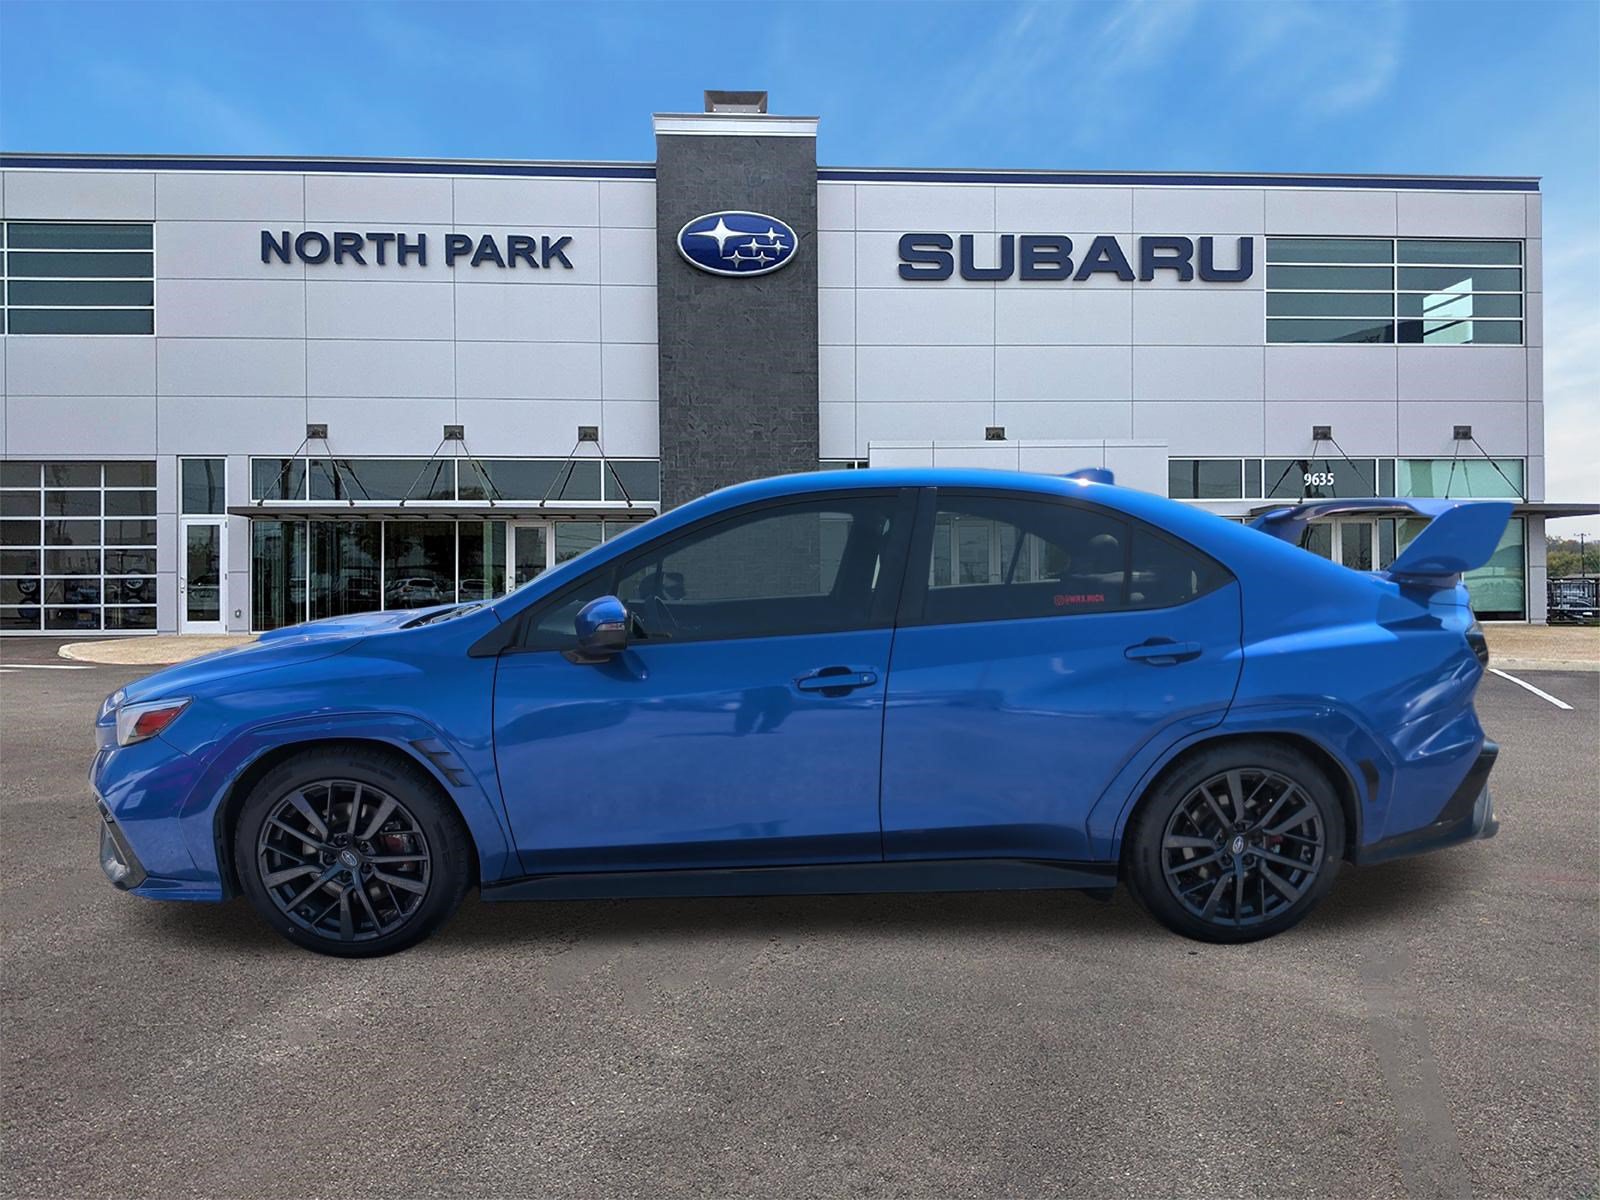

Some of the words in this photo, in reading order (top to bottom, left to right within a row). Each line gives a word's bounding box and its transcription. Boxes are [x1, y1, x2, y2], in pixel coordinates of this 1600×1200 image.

[261, 231, 427, 266] NORTH
[445, 234, 573, 269] PARK
[898, 233, 1254, 282] SUBARU
[1304, 472, 1335, 486] 9635
